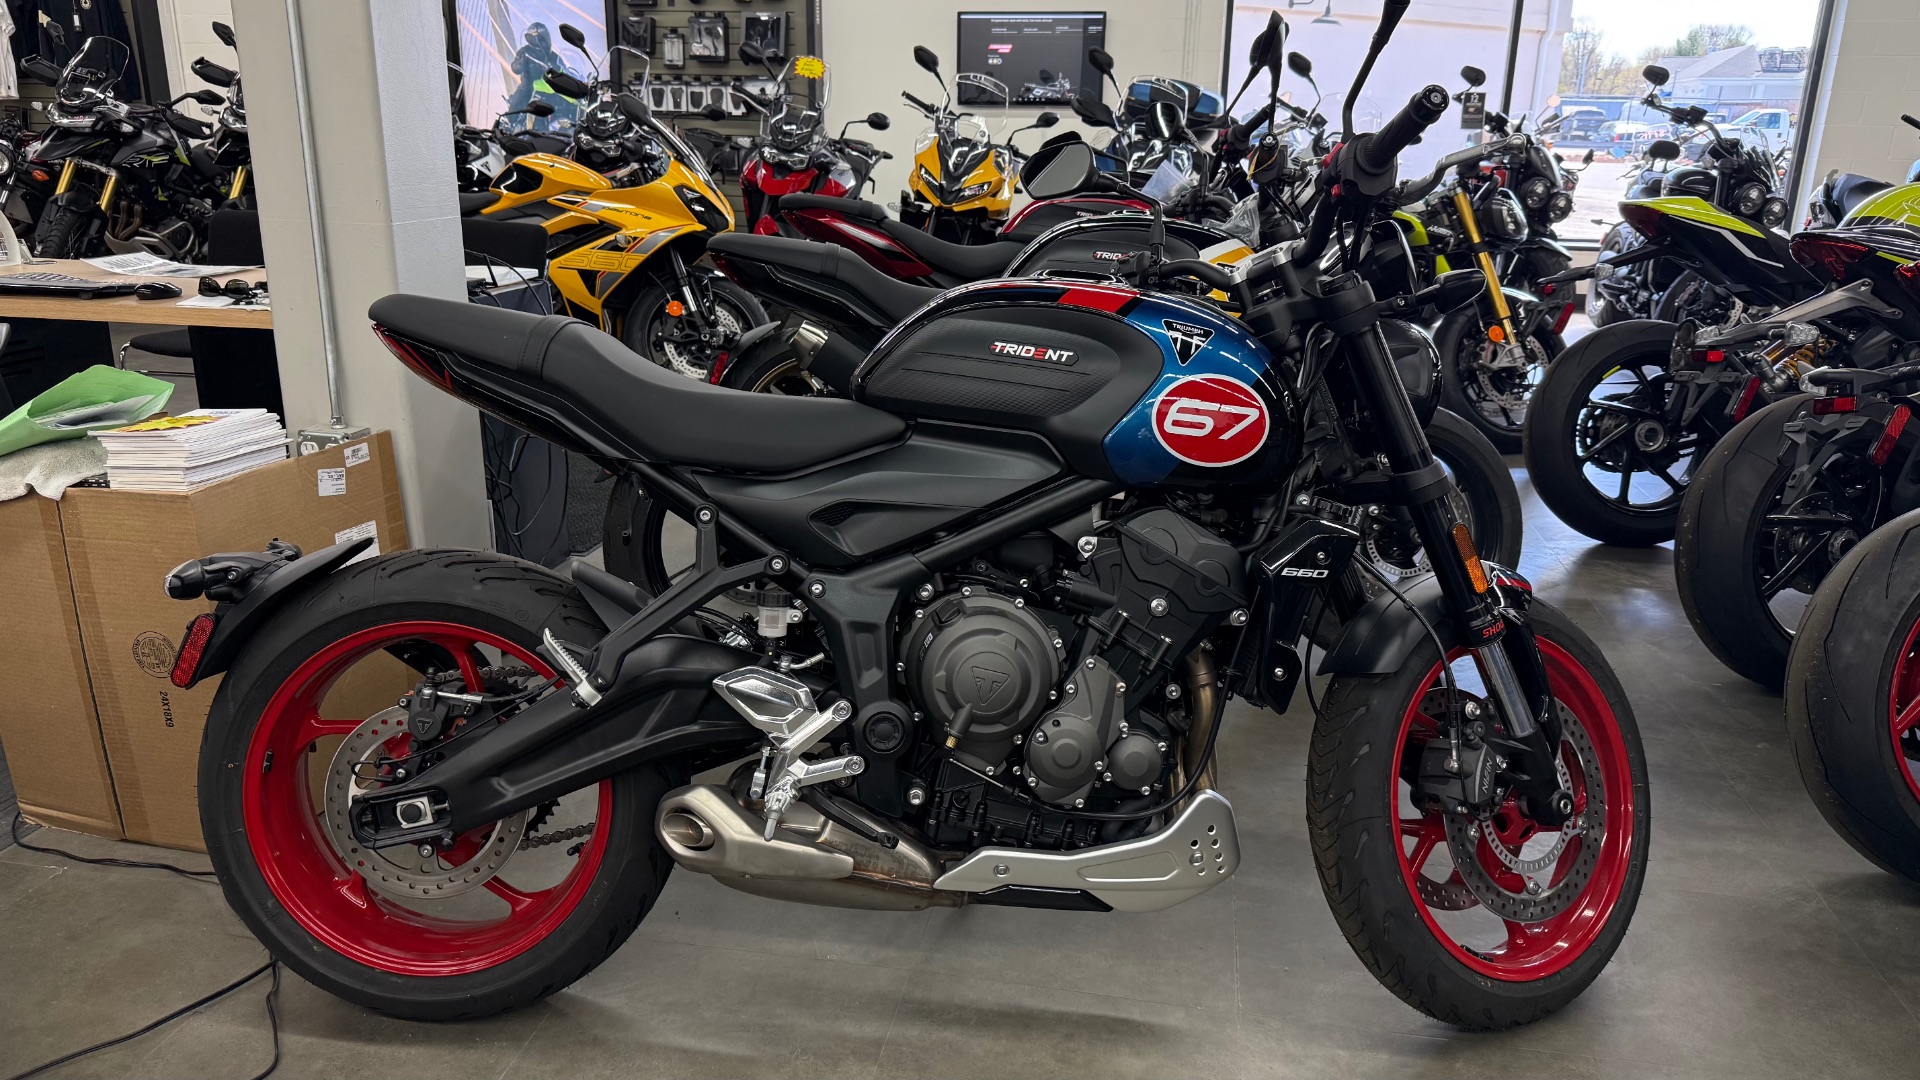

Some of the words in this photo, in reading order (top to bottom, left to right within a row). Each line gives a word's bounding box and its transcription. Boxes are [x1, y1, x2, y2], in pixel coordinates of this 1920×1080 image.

[1093, 251, 1129, 260] TRID
[1172, 323, 1204, 335] TRIUMPH
[991, 341, 1074, 362] TRIDENT
[1163, 400, 1260, 440] 67
[1281, 567, 1330, 578] 660
[1482, 621, 1505, 639] SHO
[159, 691, 175, 728] 24X18X9
